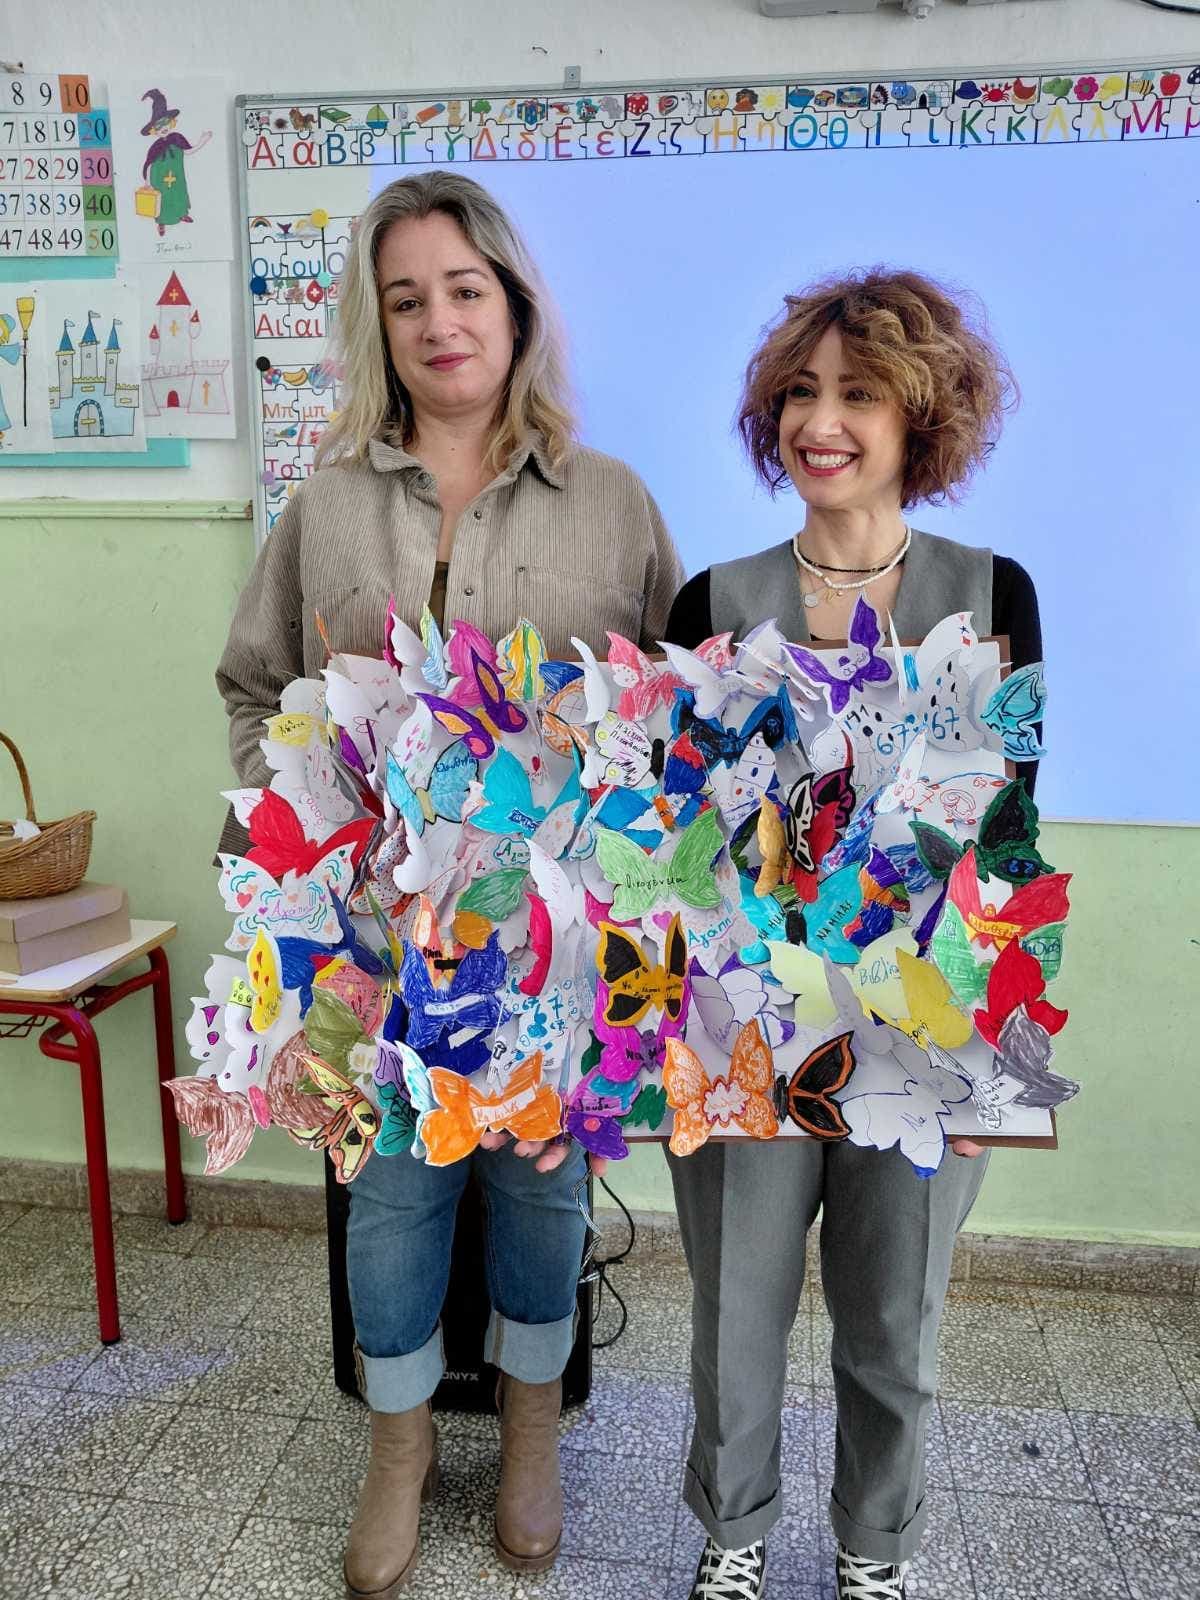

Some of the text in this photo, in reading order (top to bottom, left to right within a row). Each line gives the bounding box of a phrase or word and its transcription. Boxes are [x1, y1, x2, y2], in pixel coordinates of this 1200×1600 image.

[11, 81, 88, 107] 8 9 10
[23, 121, 46, 144] 18
[53, 119, 75, 142] 19
[80, 118, 107, 142] 20
[251, 136, 276, 167] Α
[293, 141, 317, 165] α
[326, 133, 347, 164] Β
[359, 132, 375, 163] β
[400, 131, 416, 163] Γ
[445, 130, 464, 160] γ
[473, 128, 497, 159] Δ
[517, 131, 536, 159] δ
[554, 125, 573, 158] Ε
[596, 130, 614, 156] ε
[630, 122, 651, 155] Ζ
[670, 123, 682, 154] ζ
[712, 116, 737, 150] Η
[758, 120, 775, 148] η
[789, 114, 818, 149] Θ
[828, 116, 849, 149] θ
[960, 109, 983, 144] Κ
[1042, 105, 1069, 141] Λ
[1087, 104, 1109, 140] λ
[1124, 99, 1164, 134] Μ
[24, 157, 49, 180] 28
[54, 157, 78, 180] 29
[84, 156, 109, 180] 30
[0, 192, 112, 215] 37 38 39 40
[0, 228, 114, 250] 47 48 49 50
[256, 313, 323, 337] Αι αι
[932, 706, 960, 739] 67
[877, 724, 909, 756] 67
[688, 918, 732, 948] Αγάπη
[442, 1371, 479, 1382] ONYX
